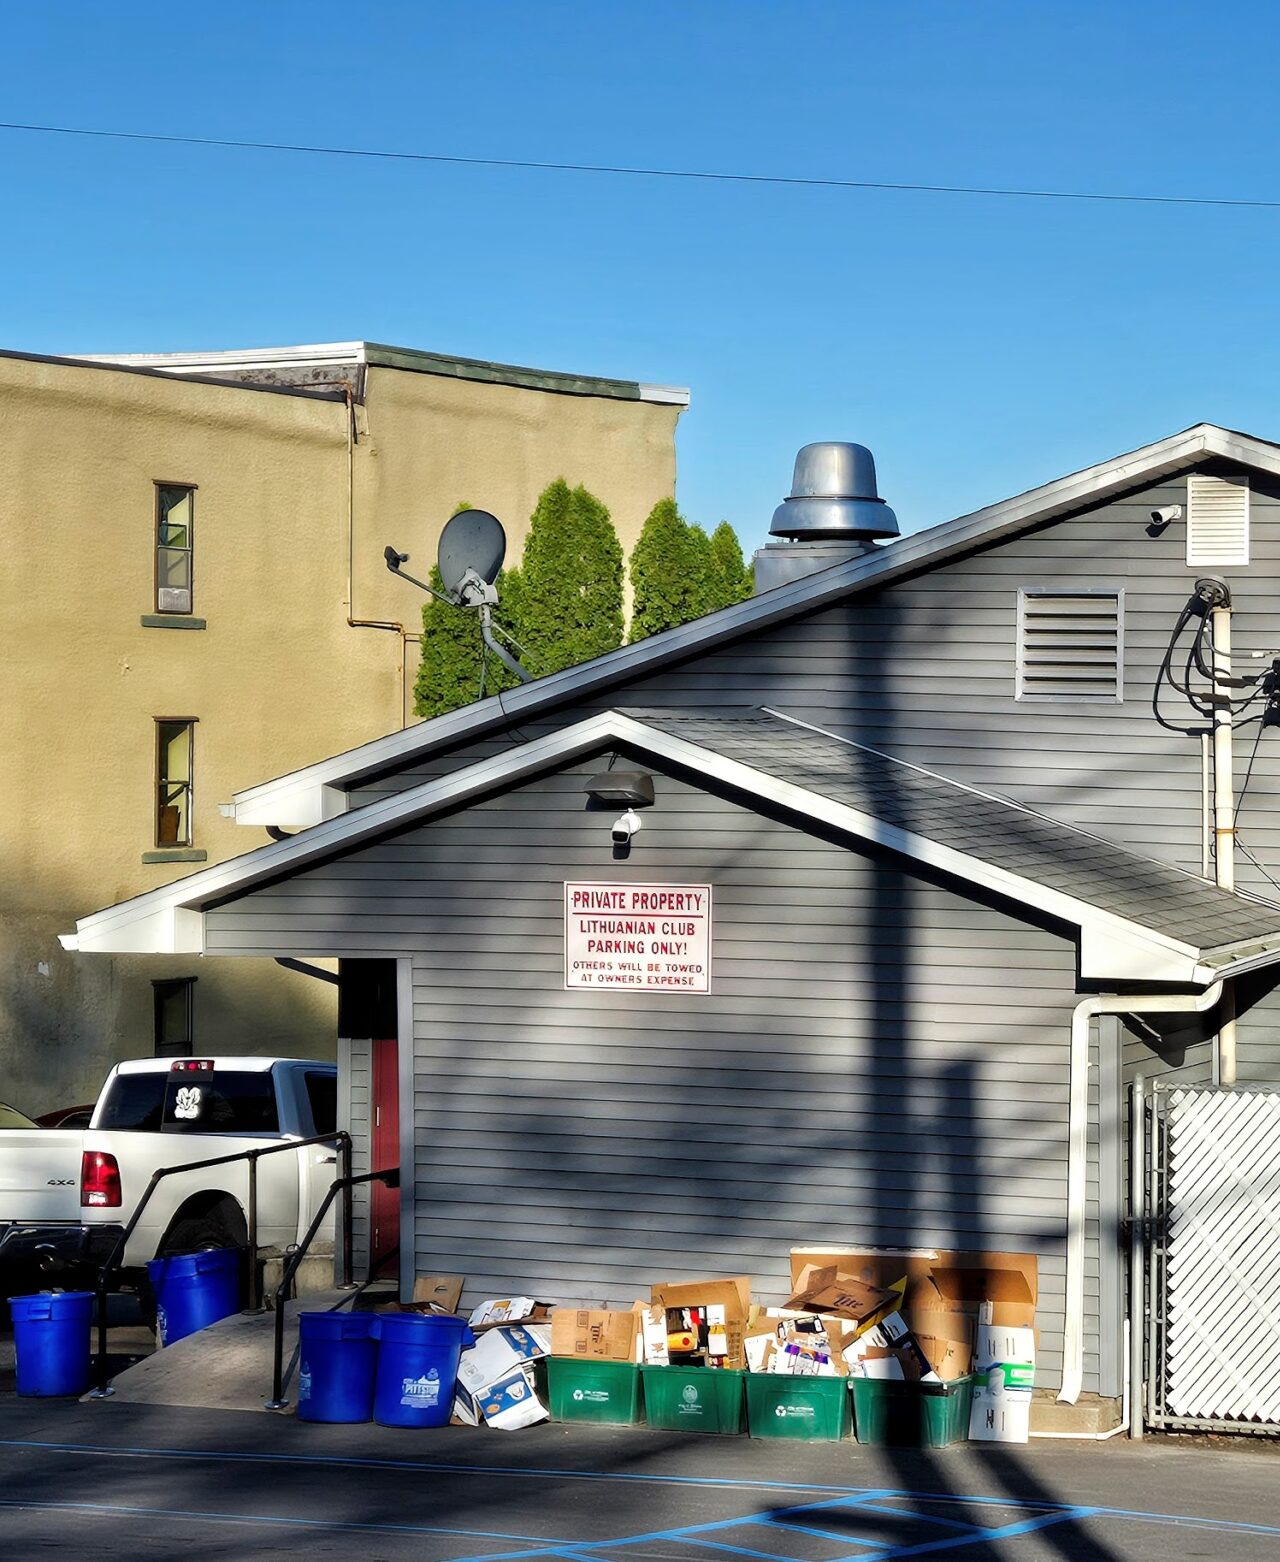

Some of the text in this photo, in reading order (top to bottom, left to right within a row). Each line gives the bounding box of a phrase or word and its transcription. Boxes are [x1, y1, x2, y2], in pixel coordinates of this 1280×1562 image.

[573, 891, 702, 911] PRIVATE PROPERTY
[580, 920, 695, 936] LITHUANIAN CLUB
[587, 940, 687, 955] PARKING ONLY!
[573, 960, 702, 974] OTHERS WILL BE TOWED
[581, 973, 695, 986] AT OWNERS EXPENSE
